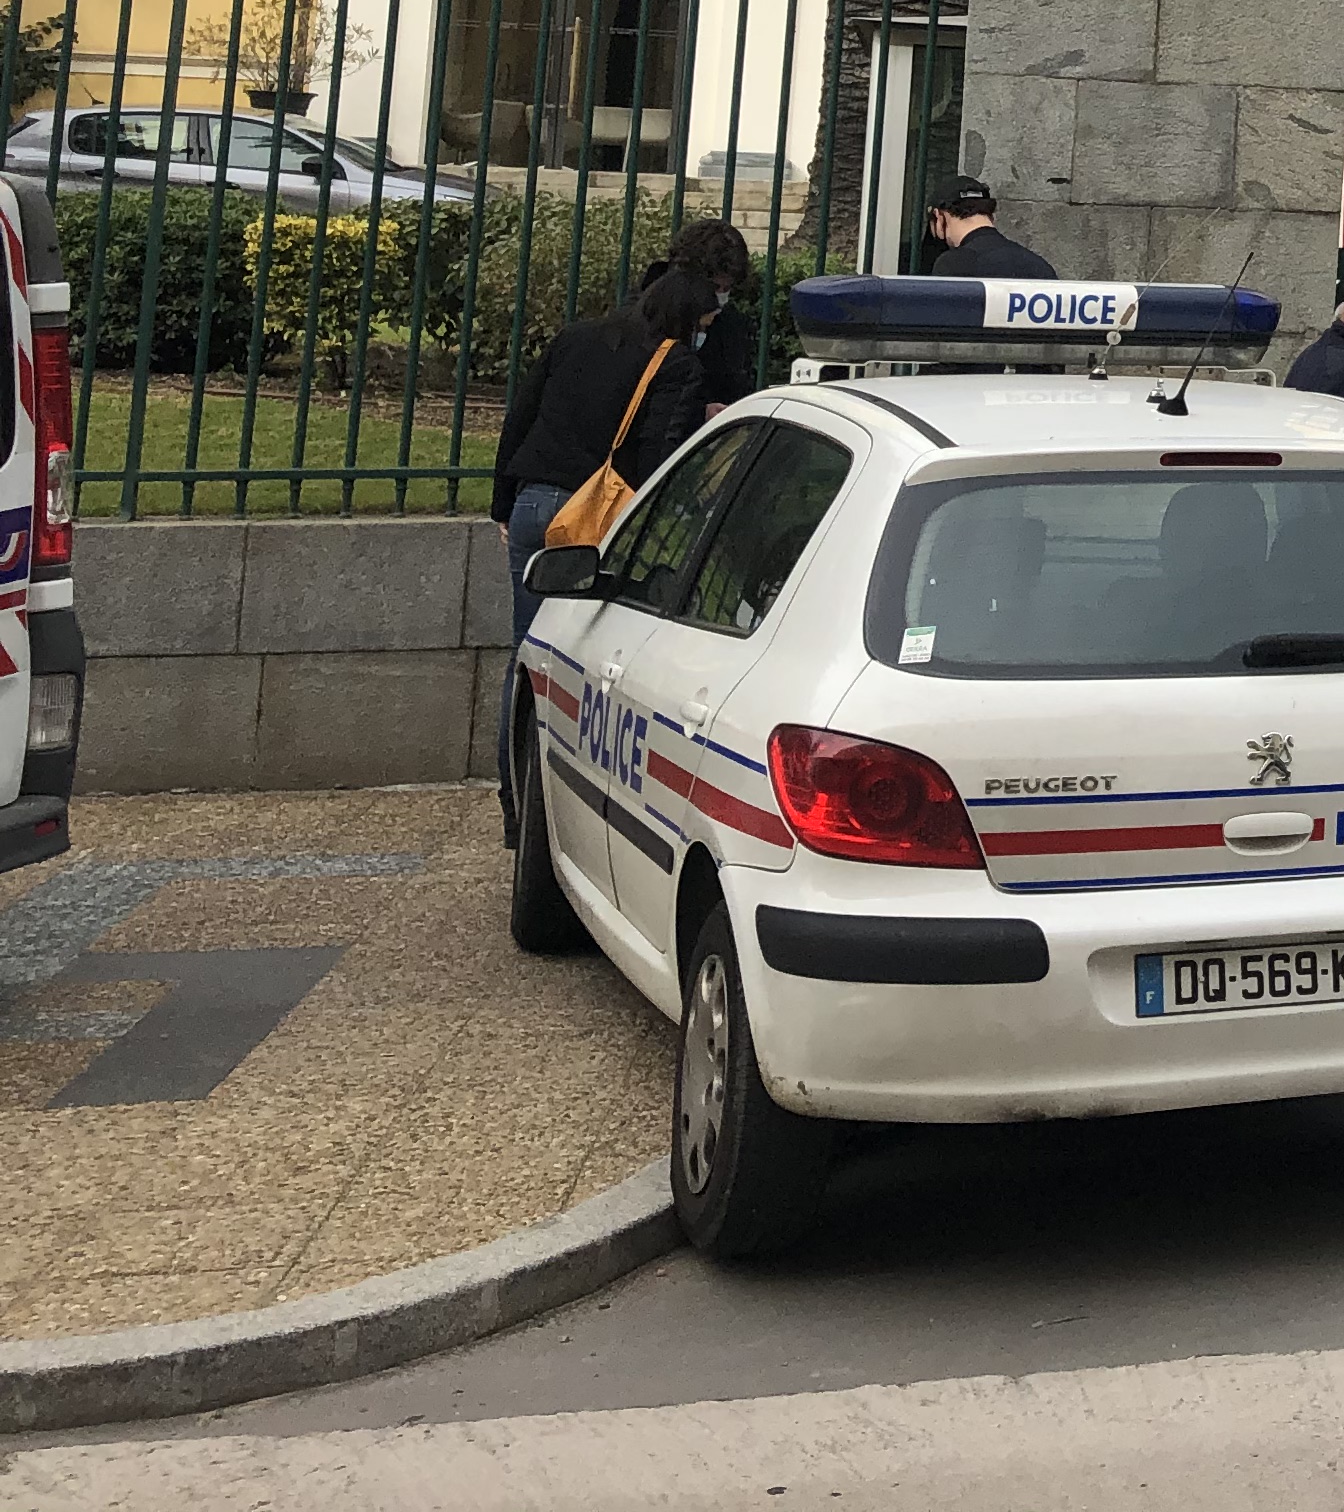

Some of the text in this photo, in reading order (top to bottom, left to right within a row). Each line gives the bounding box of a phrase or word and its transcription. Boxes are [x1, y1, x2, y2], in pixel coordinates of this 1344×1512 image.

[1007, 292, 1116, 325] POLICE
[578, 680, 648, 795] POLICE
[984, 775, 1118, 795] PEUGEOT
[1145, 990, 1156, 1005] F
